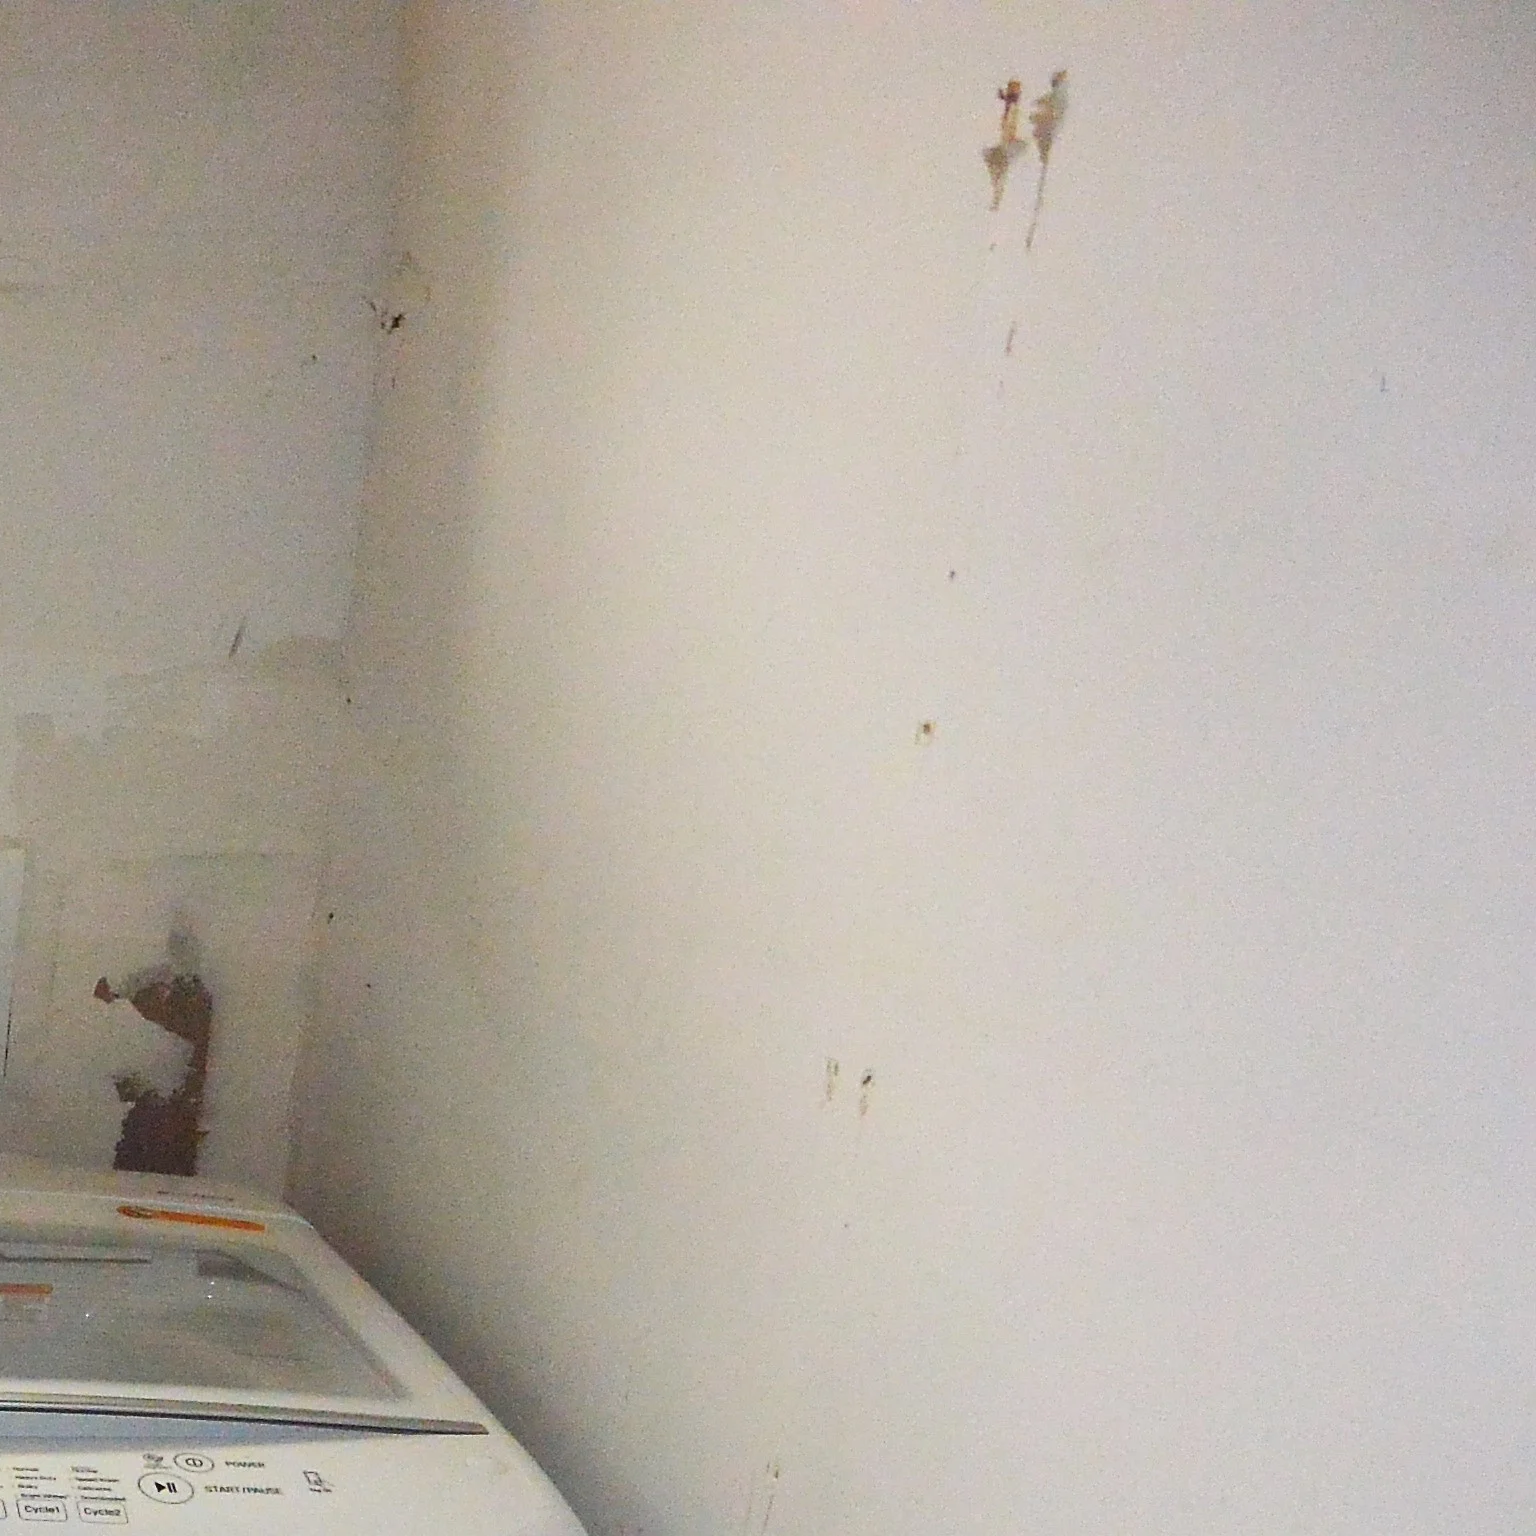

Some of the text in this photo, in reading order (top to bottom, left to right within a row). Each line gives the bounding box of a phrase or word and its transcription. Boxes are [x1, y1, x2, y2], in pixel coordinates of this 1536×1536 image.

[225, 1460, 266, 1469] POWER
[204, 1485, 284, 1495] START/PAUSE
[24, 1504, 60, 1514] Cycle1
[83, 1507, 121, 1517] Cycle2
